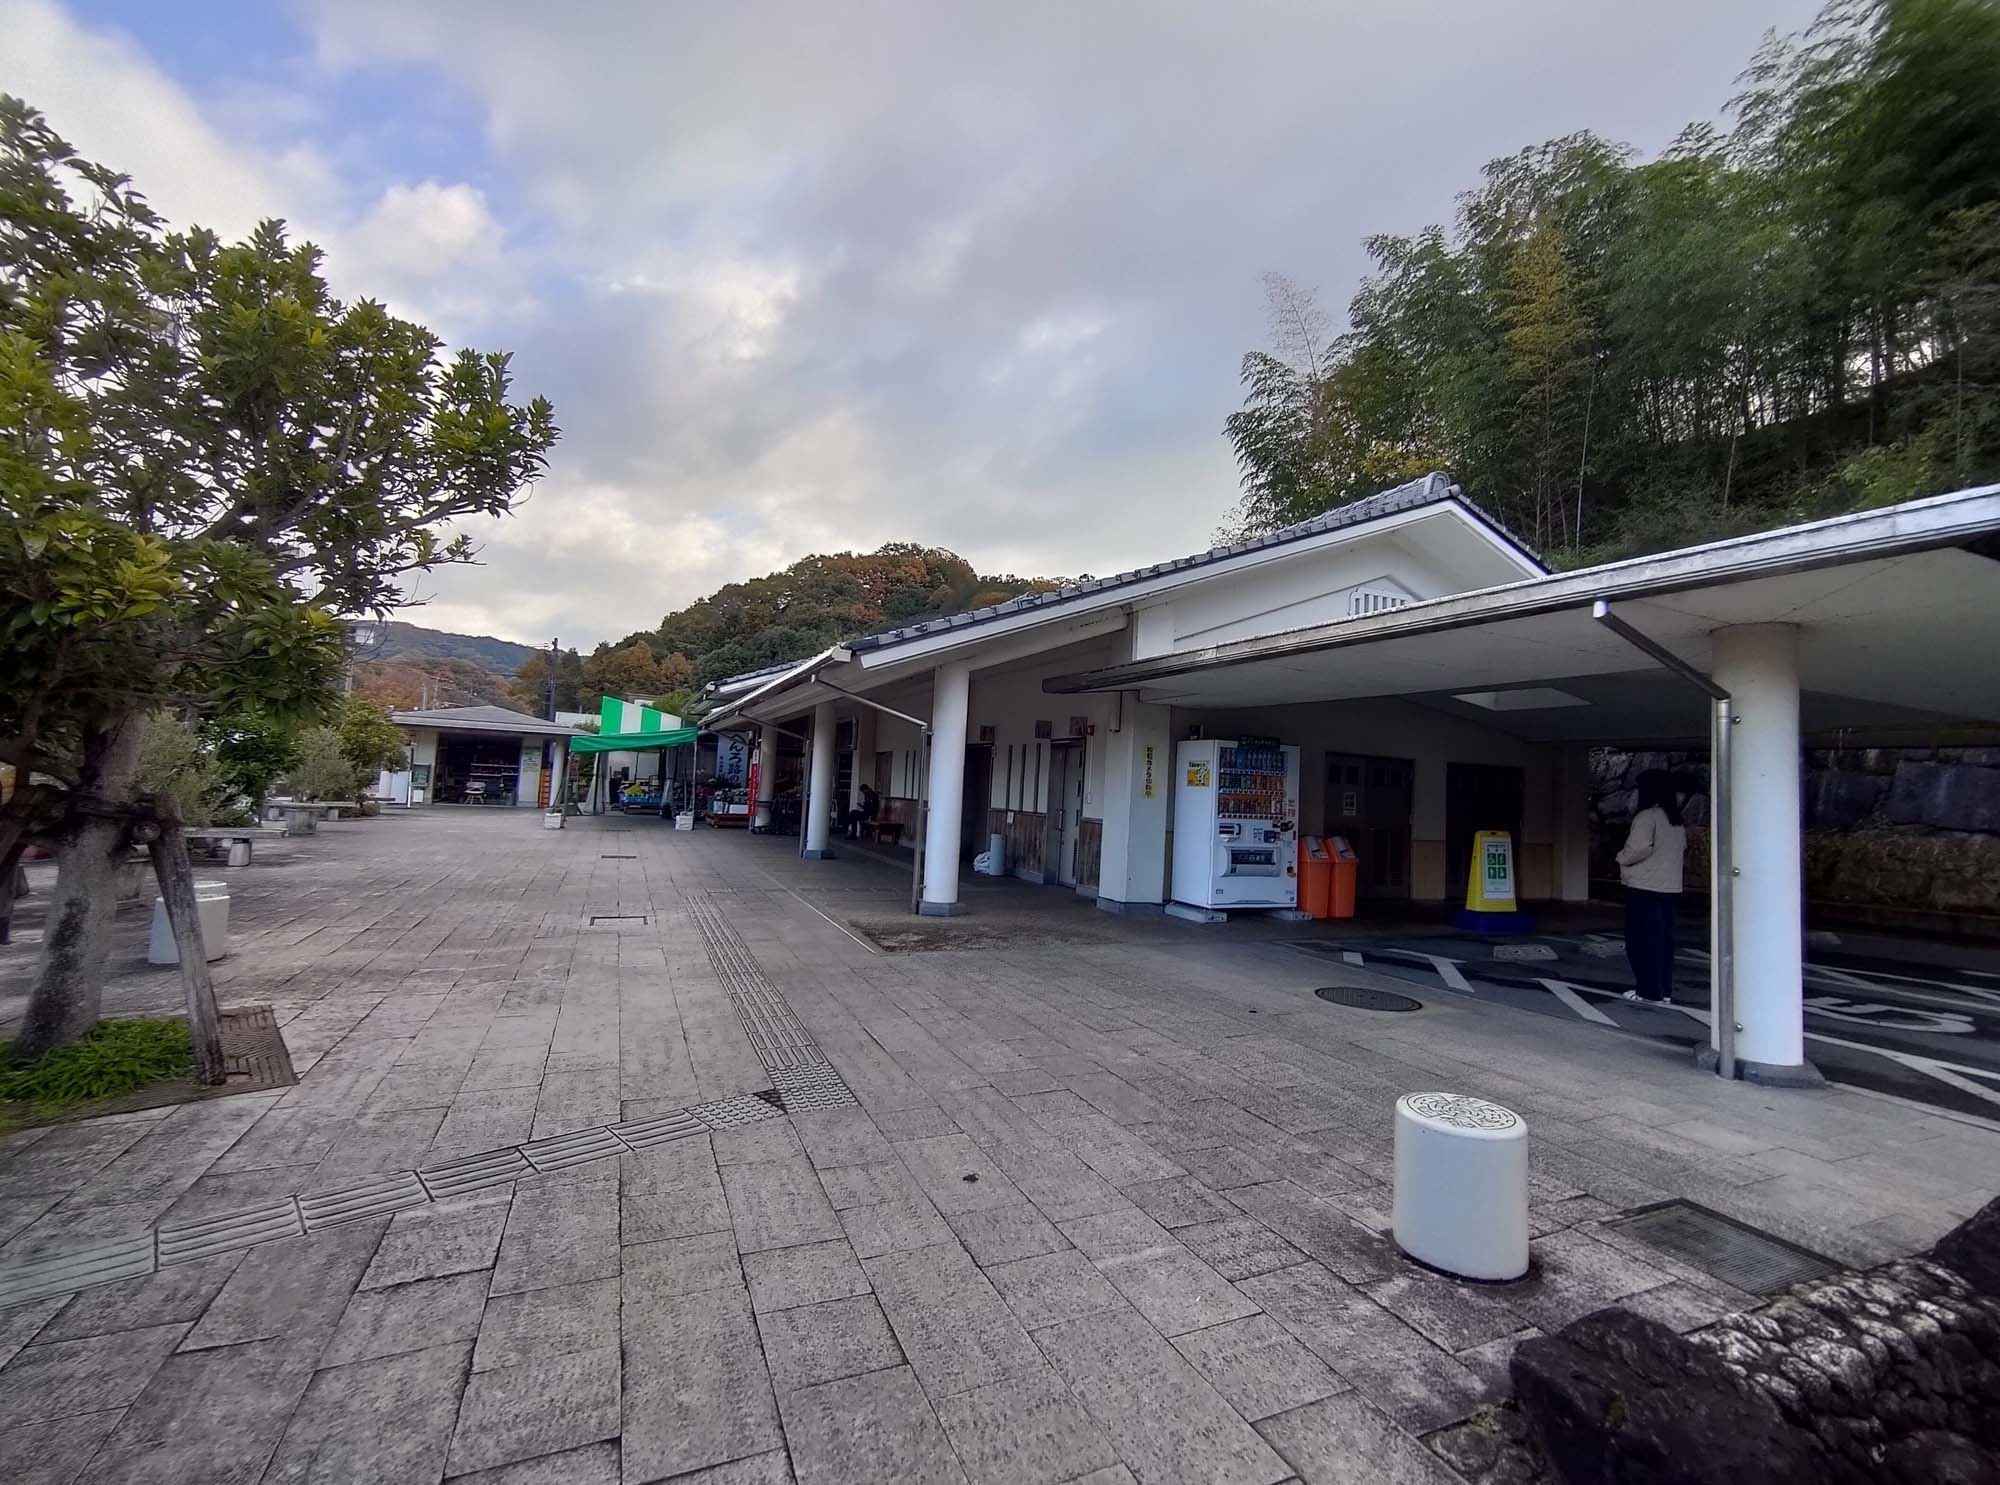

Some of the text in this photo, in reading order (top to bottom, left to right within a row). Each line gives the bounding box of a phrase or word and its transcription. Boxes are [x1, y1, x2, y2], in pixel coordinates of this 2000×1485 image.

[727, 733, 748, 785] へんろ路の
